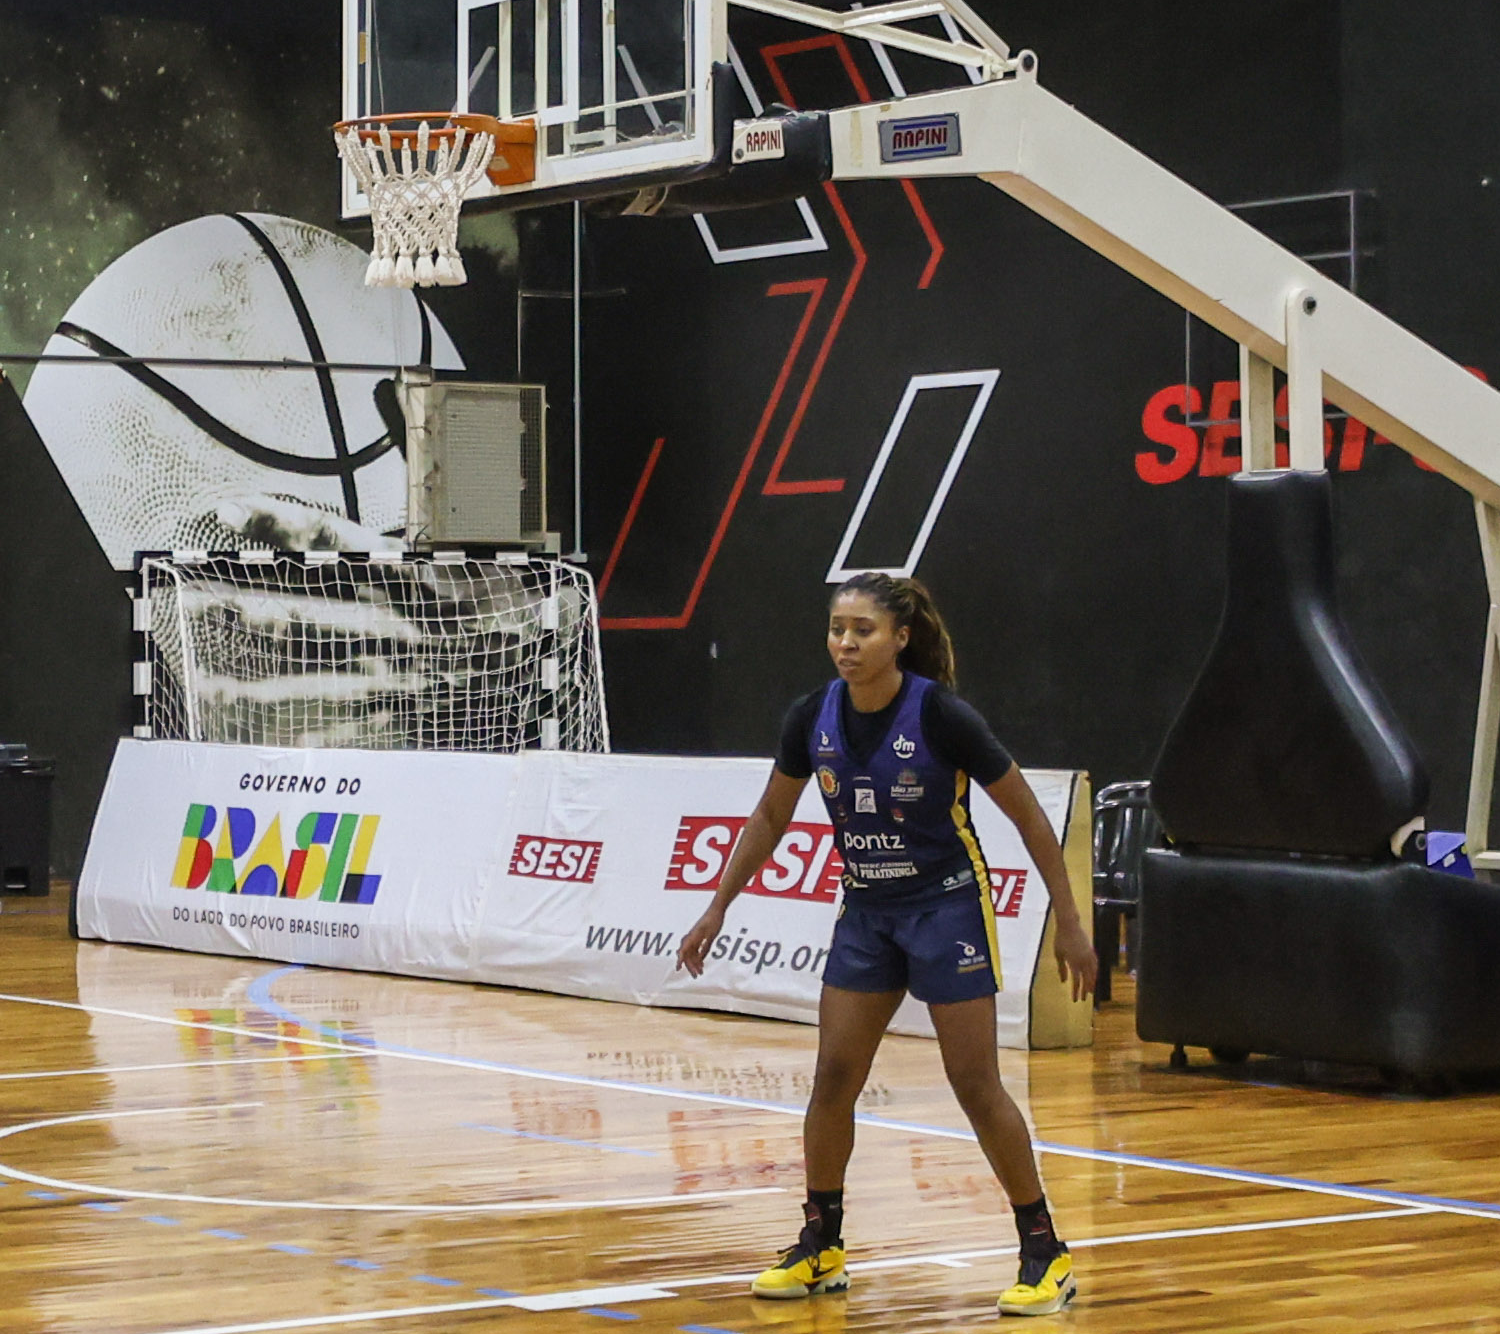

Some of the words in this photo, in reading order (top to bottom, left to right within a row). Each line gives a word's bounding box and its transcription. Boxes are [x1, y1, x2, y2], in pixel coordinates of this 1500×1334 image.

[746, 129, 781, 153] RAPINI
[892, 127, 948, 150] RAPINI
[239, 773, 326, 794] GOVERNO
[336, 778, 362, 795] DO
[170, 803, 383, 906] BRASIL
[844, 831, 905, 850] pontz
[515, 840, 595, 880] SESI
[173, 907, 190, 922] DO
[194, 910, 223, 926] LADO
[229, 913, 246, 928] DO
[251, 915, 285, 932] POVO
[289, 919, 360, 939] BRASILEIRO
[585, 925, 829, 974] www.sisp.or
